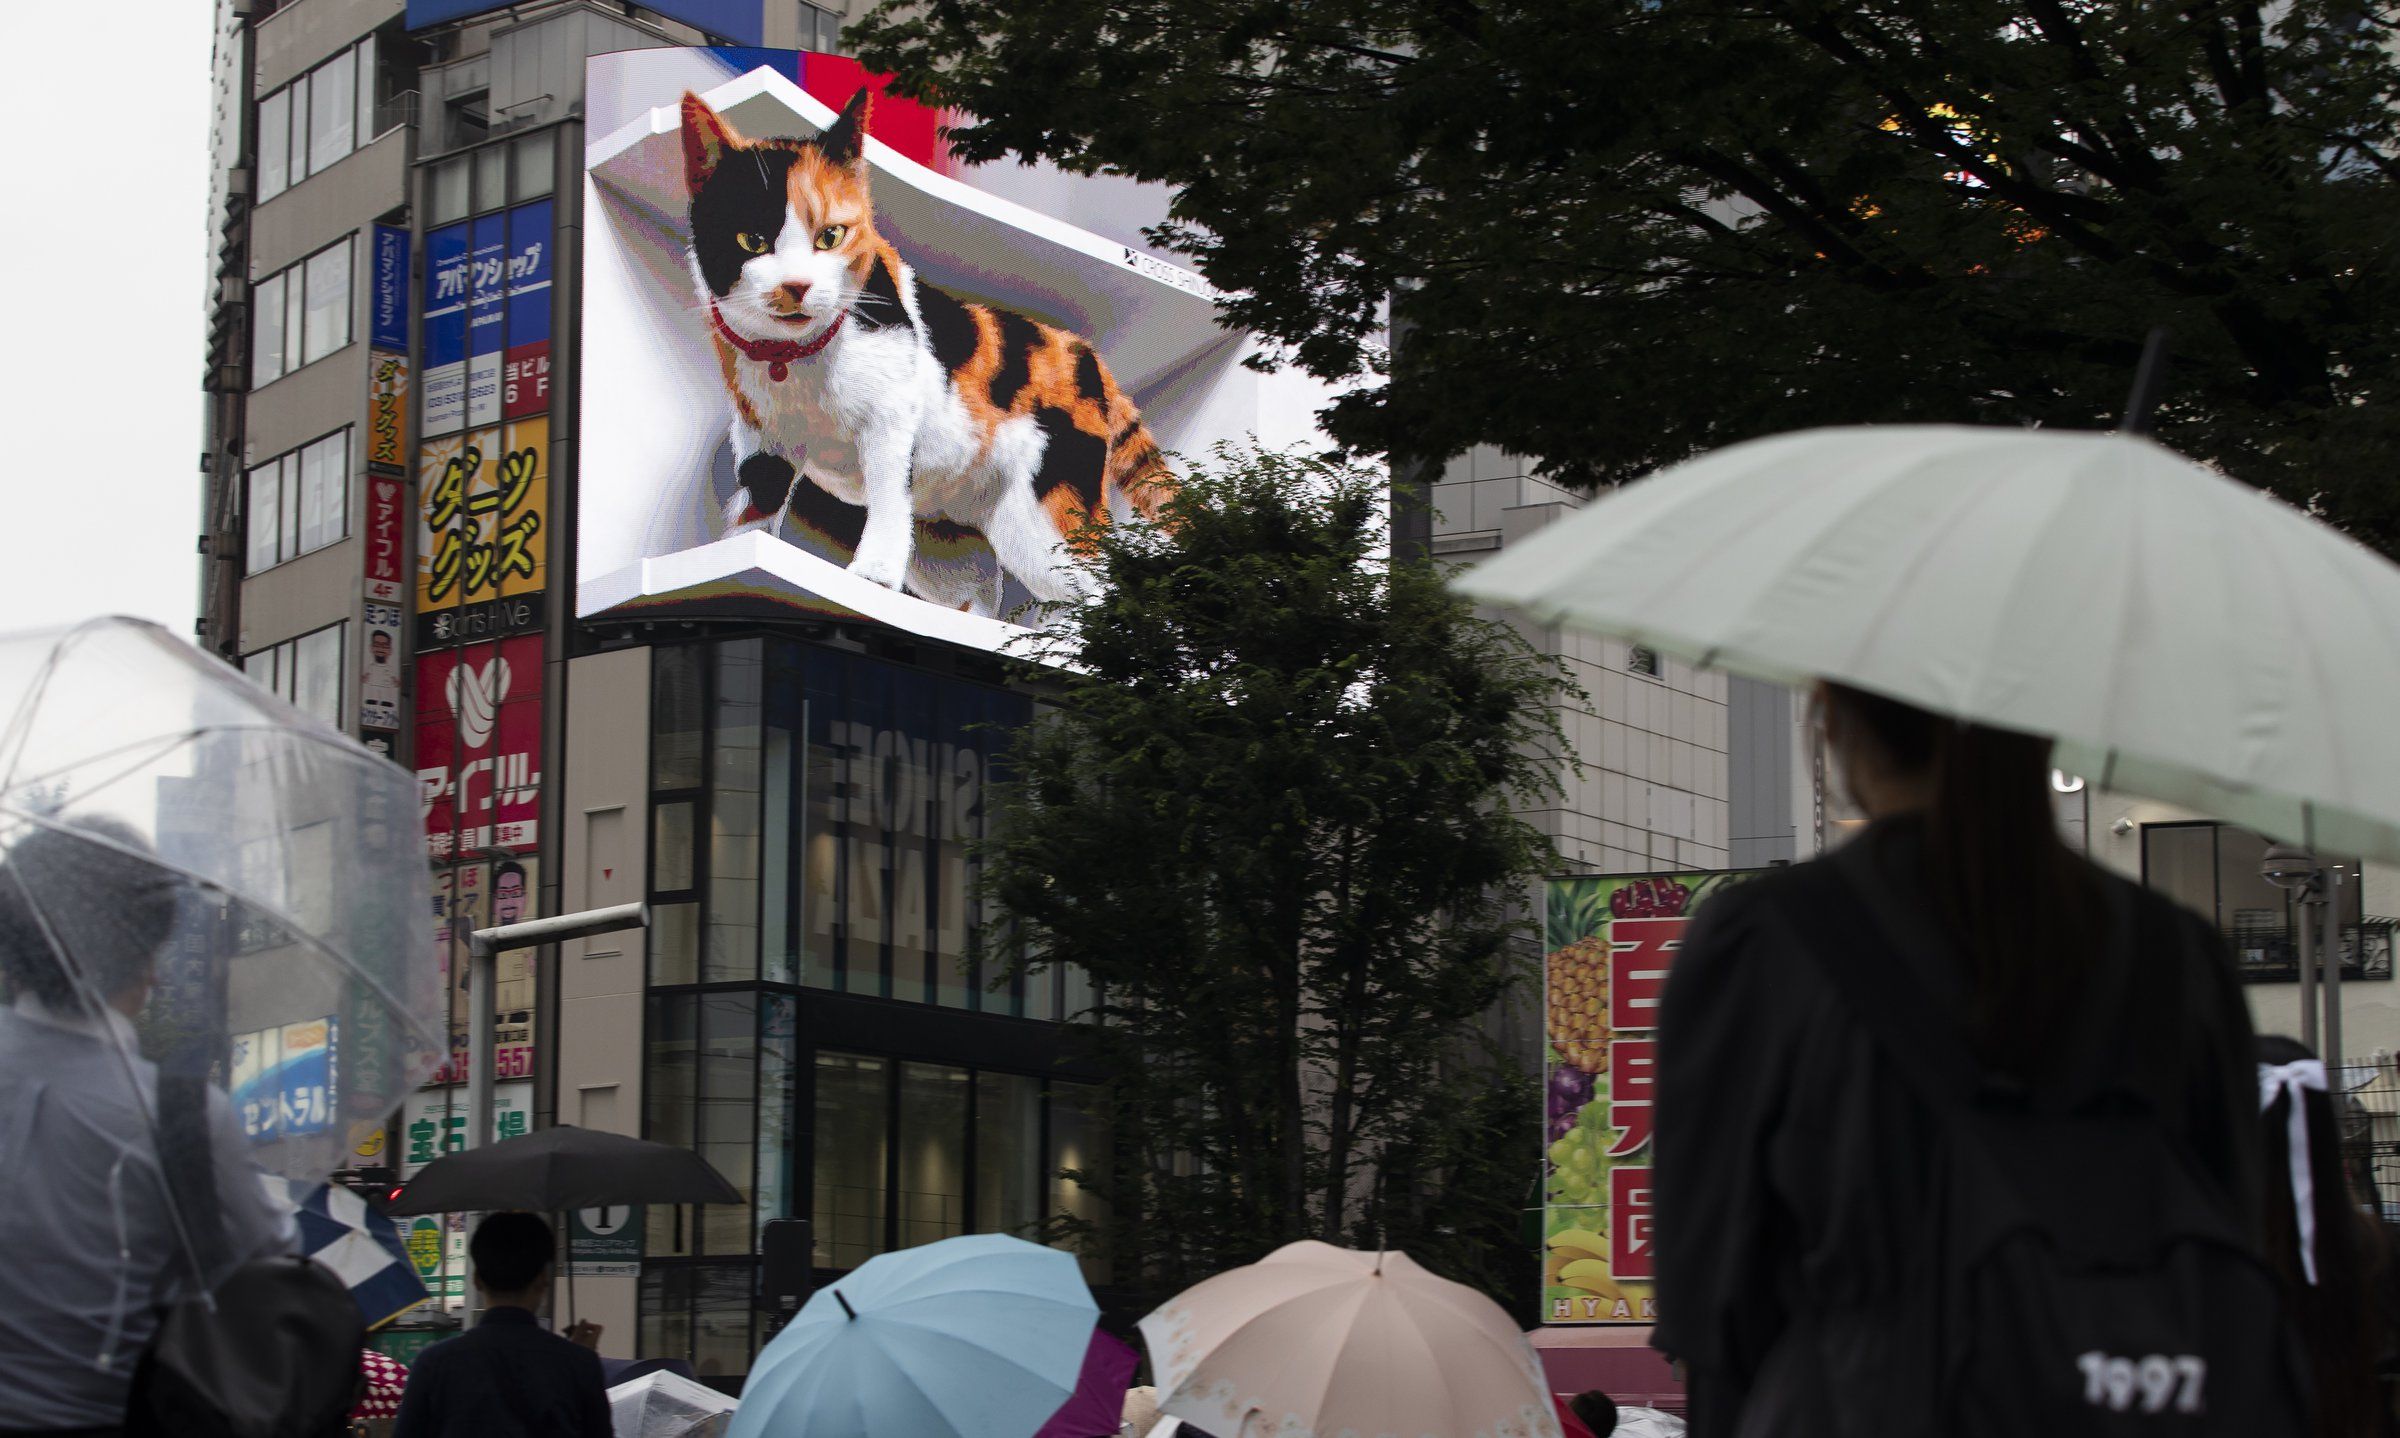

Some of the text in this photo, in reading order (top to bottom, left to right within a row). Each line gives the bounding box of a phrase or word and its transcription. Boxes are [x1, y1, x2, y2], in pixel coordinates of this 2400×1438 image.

[505, 356, 550, 381] 当ビル
[374, 358, 400, 461] ダーツグッズ
[430, 446, 537, 533] ダーツ
[374, 503, 395, 578] アイフル
[372, 584, 395, 598] 4F
[243, 1086, 327, 1136] セントラル
[2076, 1350, 2206, 1414] 1997
